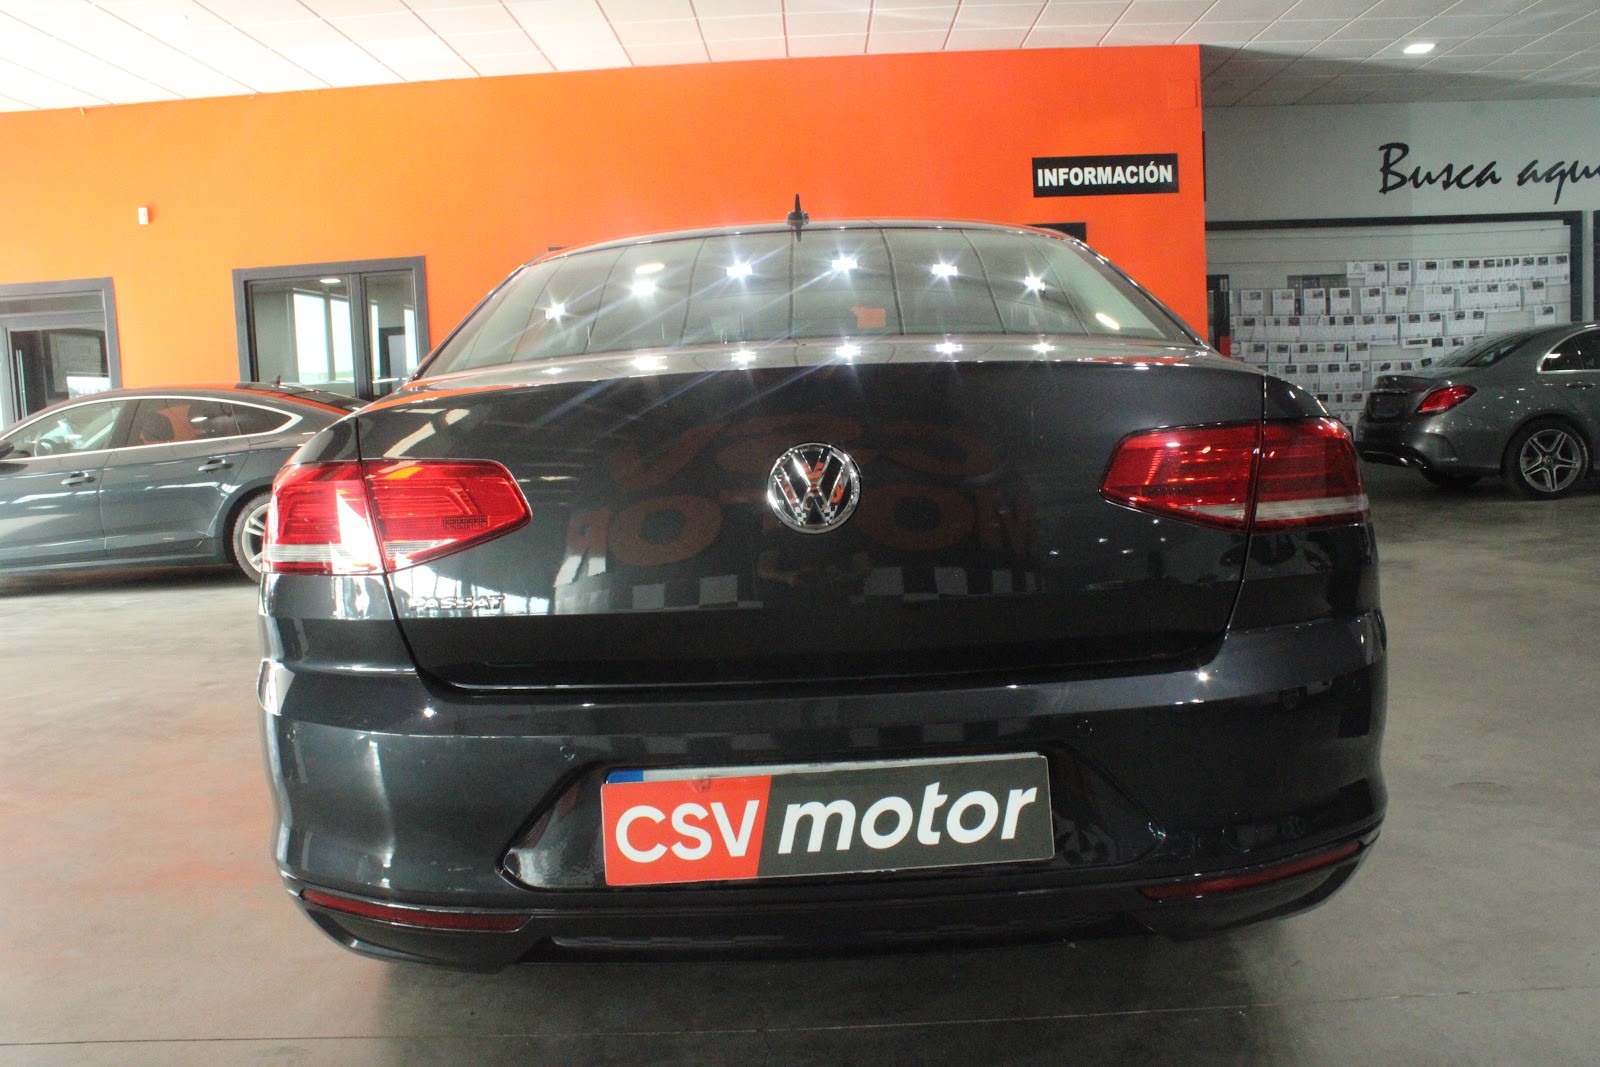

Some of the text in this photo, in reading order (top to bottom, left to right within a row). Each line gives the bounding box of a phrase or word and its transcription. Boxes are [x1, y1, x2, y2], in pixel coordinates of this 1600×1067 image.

[1037, 161, 1173, 187] INFORMACIÓN
[1378, 142, 1502, 195] Busca
[408, 595, 506, 611] PASSAT
[615, 781, 1038, 863] CSV motor
